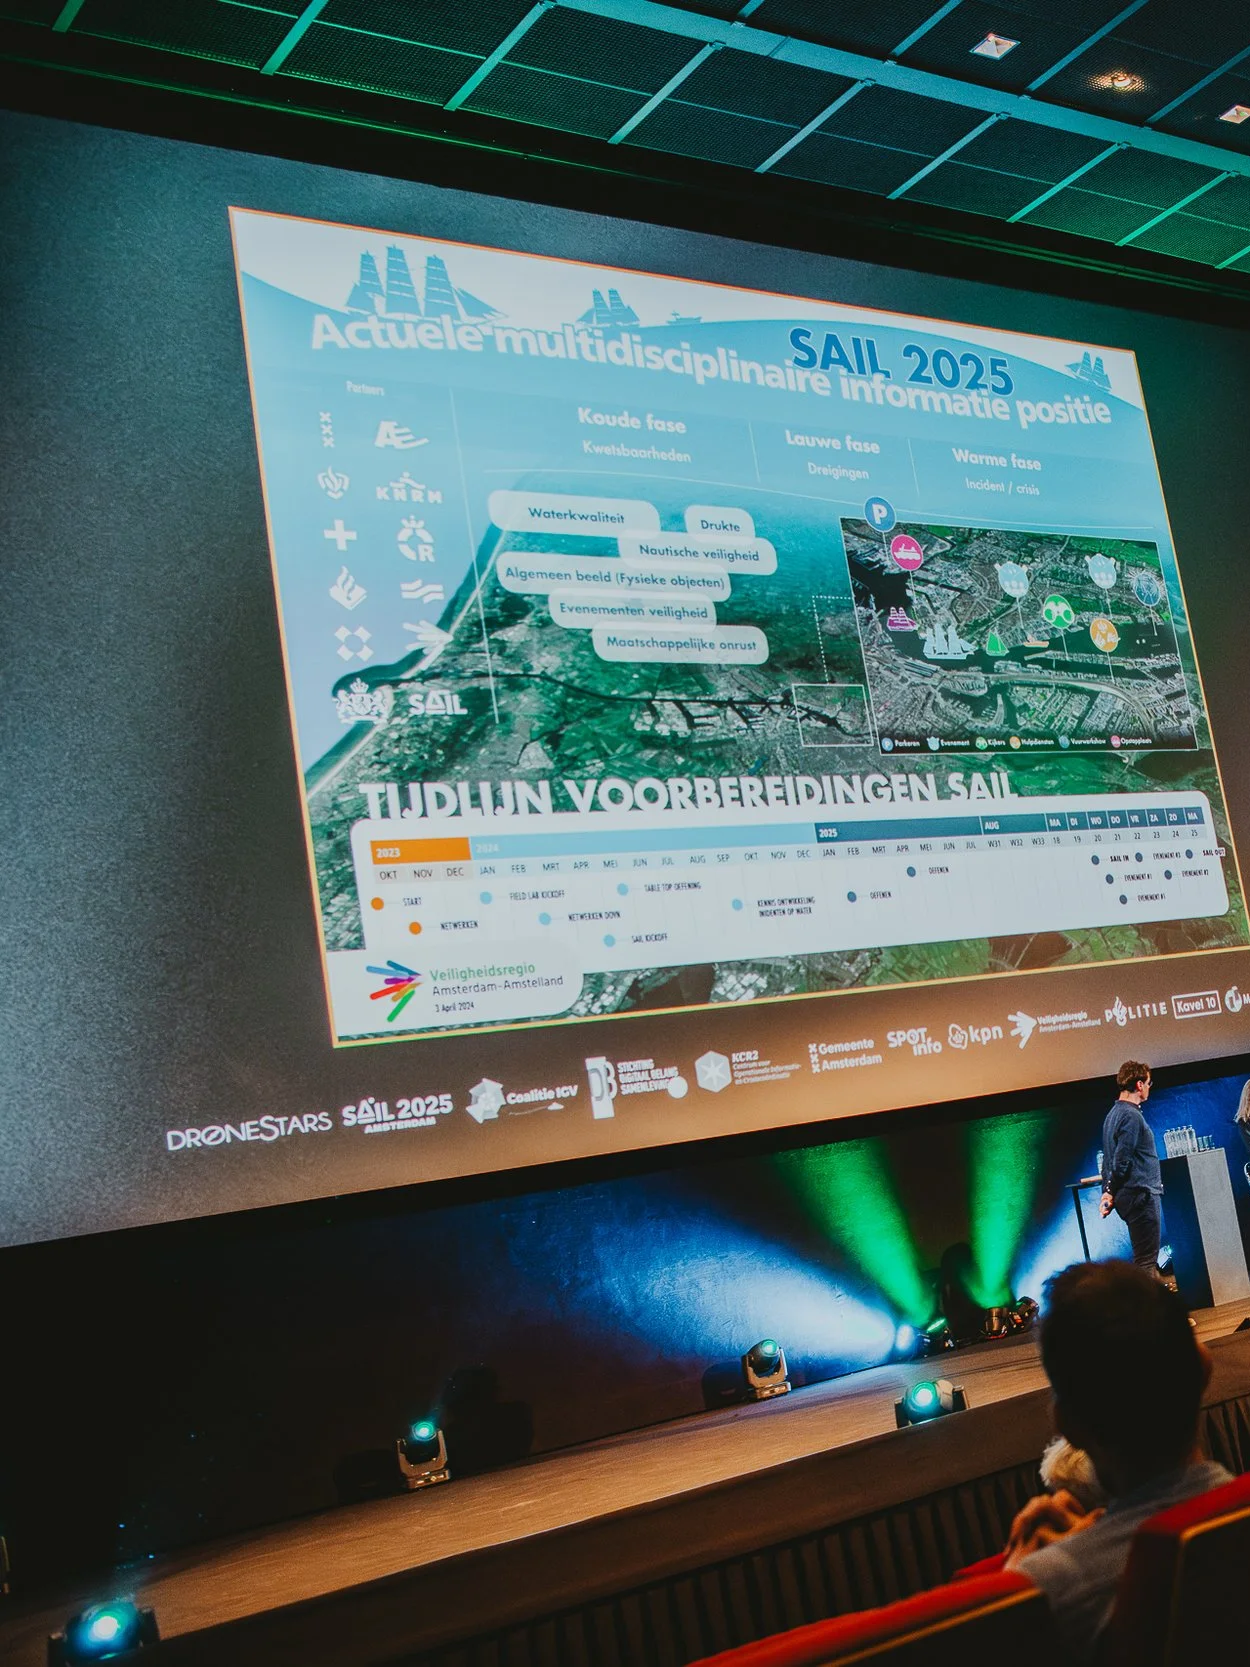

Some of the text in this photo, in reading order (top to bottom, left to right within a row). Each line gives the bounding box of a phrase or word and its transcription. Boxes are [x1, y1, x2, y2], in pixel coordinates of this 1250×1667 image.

[789, 326, 1014, 396] SAIL 2025
[311, 314, 1112, 429] Actuele multidisciplinaire informatie positie
[346, 381, 384, 396] Partners
[578, 407, 687, 434] Koude fase
[785, 429, 880, 454] Lauwe fase
[583, 440, 691, 463] Kwetsbaarheden
[952, 448, 1041, 471] Warme fase
[808, 462, 869, 481] Dreigingen
[376, 486, 443, 504] KNRM
[966, 478, 1004, 492] Incident
[1016, 484, 1040, 495] crisis
[528, 507, 625, 524] Waterkwaliteit
[873, 503, 888, 525] P
[701, 519, 741, 532] Drukte
[639, 544, 760, 563] Nautische veiligheid
[505, 567, 725, 590] Algemeen beeld (Fysieke objecten)
[559, 603, 708, 620] Evenementen veiligheid
[606, 636, 757, 653] Maatschappelijke onrust
[408, 689, 468, 715] SAIL
[359, 772, 1018, 819] TIJDLIJN VOORBEREIDINGEN SAIL
[1049, 818, 1061, 827] MA
[1090, 817, 1102, 825] WO
[1130, 815, 1139, 823] VR
[1187, 812, 1198, 820] MA
[819, 828, 838, 838] 2025
[985, 821, 1000, 830] AUG
[376, 848, 401, 858] 2023
[476, 843, 499, 853] 2024
[380, 871, 398, 880] OKT
[414, 869, 433, 879] NOV
[447, 867, 464, 877] DEC
[480, 866, 496, 876] JAN
[511, 864, 526, 873] FEB
[543, 862, 560, 871] MRT
[574, 861, 589, 870] APR
[603, 859, 618, 868] MEI
[633, 858, 647, 867] JUN
[662, 857, 674, 865] JUL
[690, 855, 706, 864] AUG
[718, 854, 730, 862] SEP
[745, 852, 758, 861] OKT
[771, 851, 786, 860] NOV
[798, 849, 810, 858] DEC
[823, 848, 836, 857] JAN
[848, 847, 859, 856] FEB
[872, 846, 886, 854] MRT
[897, 844, 909, 853] APR
[920, 843, 932, 851] MEI
[944, 842, 955, 850] JUN
[966, 841, 976, 849] JUL
[988, 838, 1001, 848] W31
[1010, 838, 1023, 846] W32
[1032, 837, 1044, 846] W33
[1074, 835, 1081, 843] 19
[1094, 834, 1102, 842] 20
[510, 890, 565, 900] FIELD LAB KICKOFF
[644, 883, 660, 892] TABLE
[662, 883, 672, 891] TOP
[403, 897, 422, 906] START
[757, 898, 777, 907] KENNIS
[568, 912, 603, 921] NETWERKEN
[796, 907, 812, 915] WATER
[440, 920, 478, 930] NETWERKEN
[645, 933, 668, 942] KICKOFF
[429, 962, 536, 982] Veiligheidsregio
[433, 976, 564, 996] Amsterdam-Amstelland
[435, 1002, 475, 1012] 3 April 2024
[1177, 997, 1216, 1013] Kavel 10
[887, 1028, 927, 1048] SPOT
[968, 1024, 1003, 1045] kpn
[818, 1038, 875, 1055] Gemeente
[912, 1037, 942, 1056] info
[732, 1050, 759, 1063] KCR2
[822, 1053, 882, 1071] Amsterdam
[506, 1087, 555, 1105] Coalitie
[342, 1093, 453, 1127] SAIL 2025
[364, 1116, 436, 1134] AMSTERDAM
